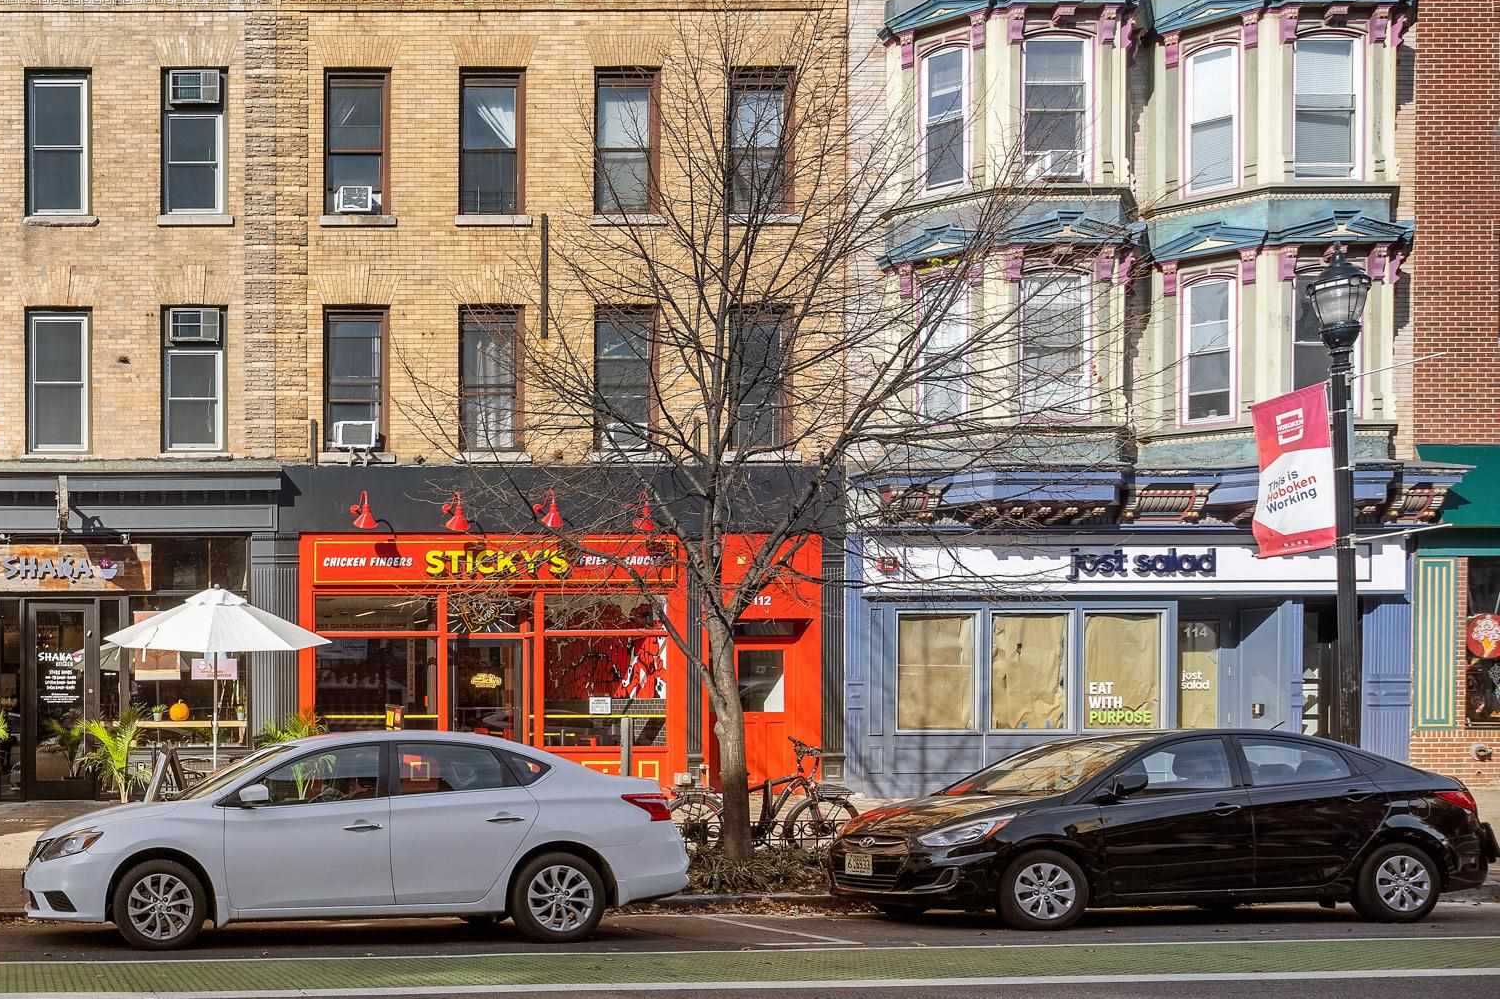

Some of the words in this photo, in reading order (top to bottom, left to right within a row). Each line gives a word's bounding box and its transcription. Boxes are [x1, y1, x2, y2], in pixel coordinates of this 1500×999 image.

[1267, 474, 1286, 493] This
[1287, 469, 1299, 481] is
[1266, 474, 1317, 504] Hoboken
[1265, 486, 1318, 514] Working
[323, 557, 367, 567] CHICKEN
[369, 557, 413, 567] FINGERS
[425, 549, 570, 574] STICKY'S
[1136, 547, 1217, 575] salad
[3, 556, 94, 580] SHAKA
[1184, 626, 1208, 638] 114
[37, 651, 73, 662] SHAKA
[1089, 681, 1114, 694] EAT
[1181, 680, 1210, 690] salad
[1089, 696, 1123, 709] WITH
[1089, 711, 1152, 724] PURPOSE
